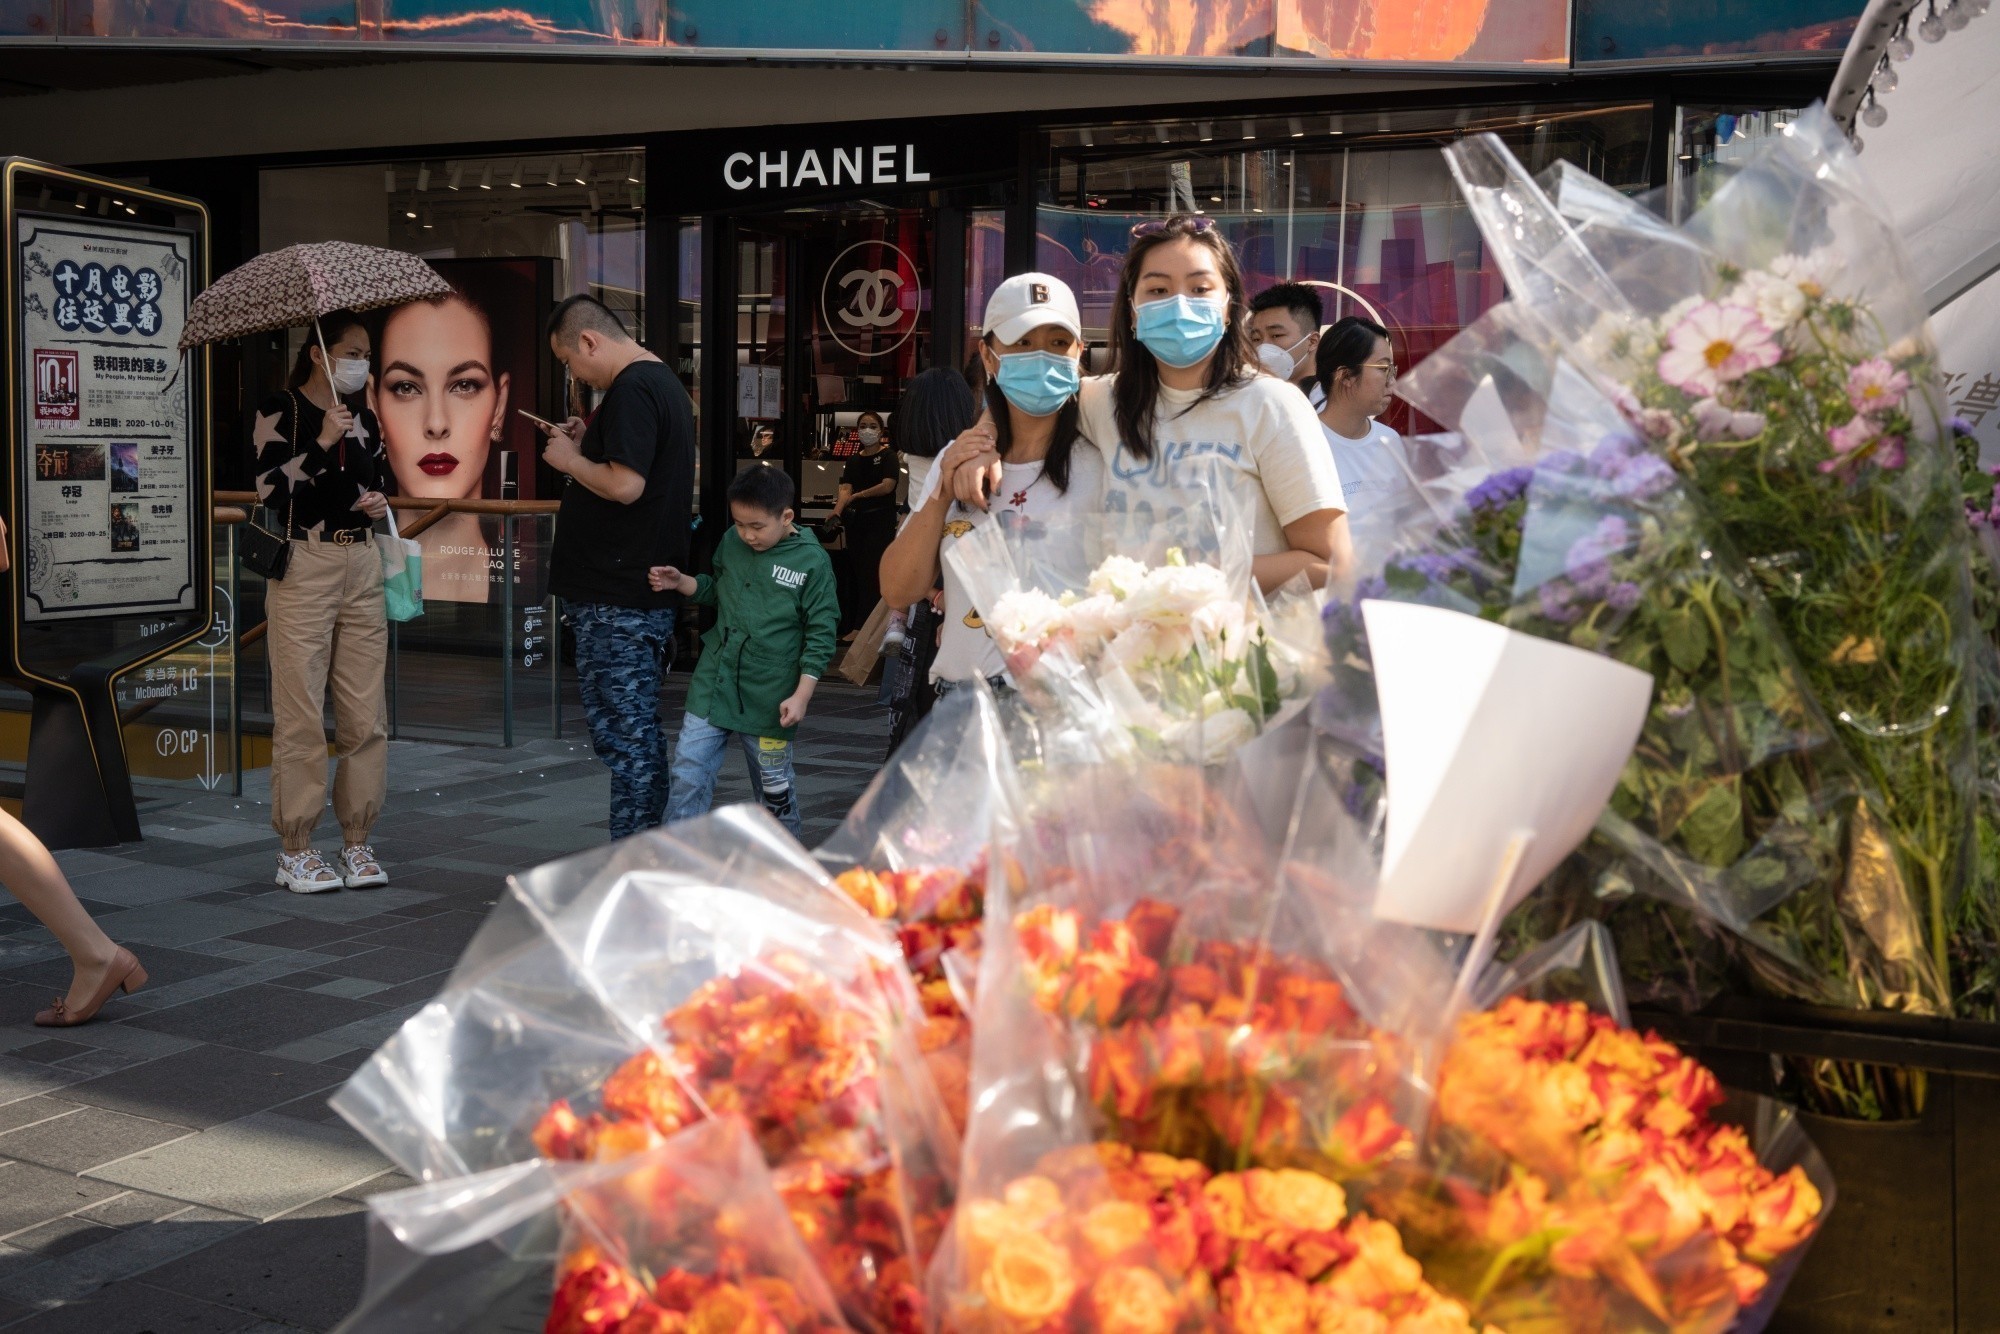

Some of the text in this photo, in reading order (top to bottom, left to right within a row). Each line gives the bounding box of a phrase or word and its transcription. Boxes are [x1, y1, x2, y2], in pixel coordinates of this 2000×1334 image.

[723, 144, 931, 190] CHANEL
[56, 264, 157, 301] 十月电影
[57, 299, 157, 332] 往这里看
[93, 355, 167, 373] 我和我的家乡
[126, 419, 175, 428] 2020-10-01
[37, 449, 68, 477] 夺冠
[61, 485, 82, 498] 夺冠
[440, 545, 521, 558] ROUGE ALLUE
[483, 560, 521, 570] LAQE
[145, 666, 177, 682] 麦当劳
[182, 667, 198, 691] LG
[135, 682, 178, 700] McDonald's
[181, 729, 198, 753] CP
